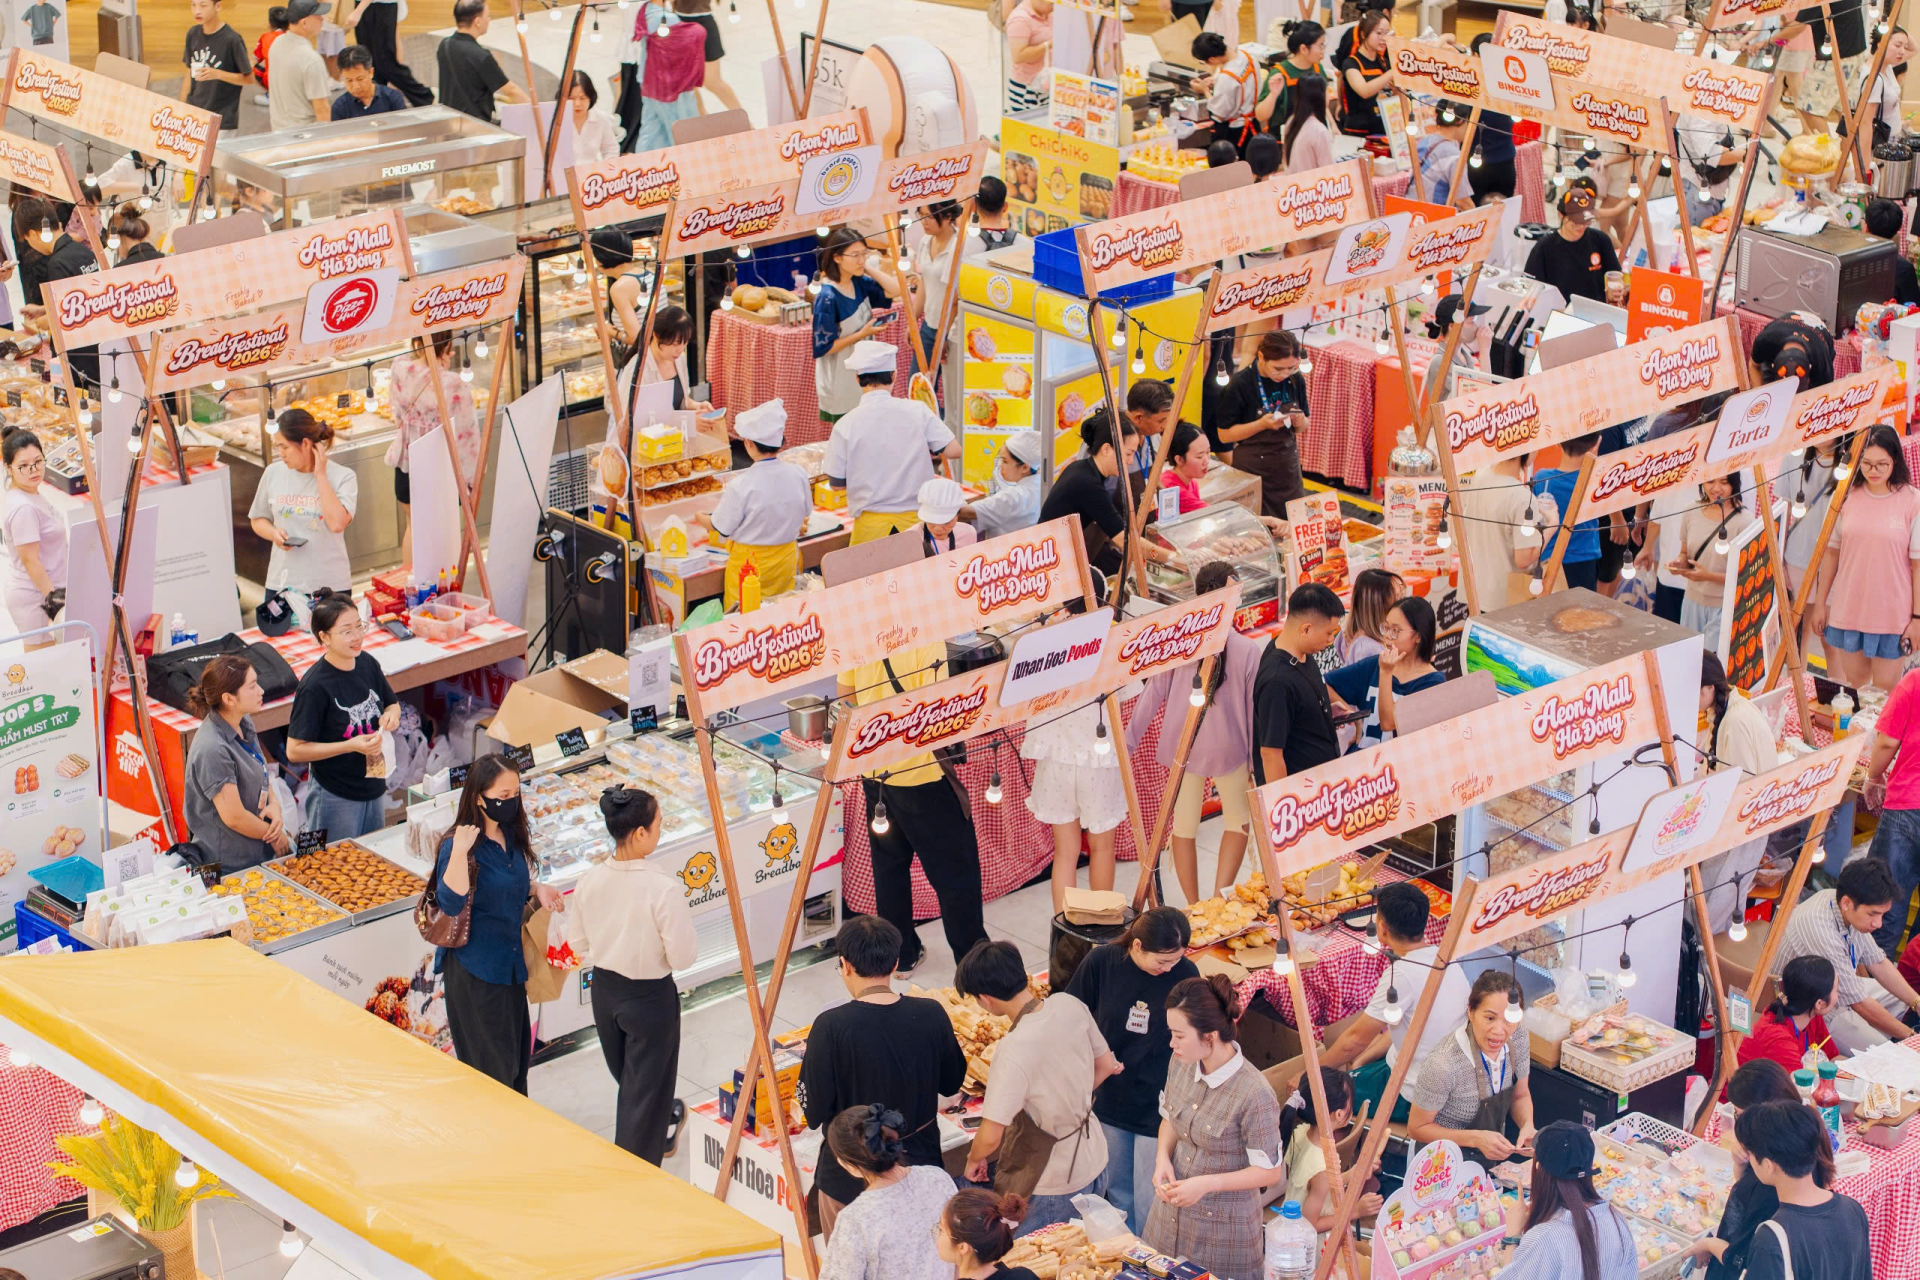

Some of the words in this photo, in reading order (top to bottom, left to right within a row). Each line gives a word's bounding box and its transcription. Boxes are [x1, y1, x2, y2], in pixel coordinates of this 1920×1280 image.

[1504, 24, 1550, 51] Bread
[1541, 36, 1589, 62] Festival
[1397, 49, 1438, 76] Bread
[1433, 60, 1479, 87] Festival
[1548, 57, 1575, 74] 2026
[16, 63, 50, 92] Bread
[43, 75, 81, 100] Festival
[1443, 80, 1470, 96] 2026
[1497, 81, 1541, 98] BINGXUE
[1683, 68, 1719, 94] Aeon
[1716, 76, 1761, 103] Mall
[47, 95, 71, 113] 2026
[1572, 92, 1613, 117] Aeon
[1610, 103, 1648, 127] Mall
[1693, 91, 1715, 110] Hà
[153, 107, 183, 129] Aeon
[181, 115, 209, 141] Mall
[1587, 114, 1610, 130] Hà
[782, 131, 825, 159] Aeon
[821, 124, 858, 148] Mall
[381, 159, 436, 178] FOREMOST
[890, 164, 936, 191] Aeon
[933, 155, 971, 180] Mall
[583, 174, 631, 208] Bread
[624, 164, 677, 199] Festival
[638, 184, 668, 206] 2026
[899, 182, 925, 203] Hà
[921, 177, 955, 198] Đông
[1279, 185, 1321, 216] Aeon
[1316, 176, 1351, 202] Mall
[680, 208, 735, 240] Bread
[729, 196, 783, 230] Festival
[1294, 207, 1319, 228] Hà
[1316, 198, 1345, 221] Đông
[735, 219, 769, 236] 2026
[1408, 232, 1450, 260] Aeon
[1446, 220, 1486, 248] Mall
[301, 235, 349, 264] Aeon
[347, 225, 391, 254] Mall
[1093, 234, 1139, 271] Bread
[1131, 221, 1181, 259] Festival
[1142, 244, 1174, 266] 2026
[1418, 251, 1445, 271] Hà
[1440, 243, 1470, 266] Đông
[320, 259, 347, 279] Hà
[344, 250, 382, 274] Đông
[61, 285, 115, 324] Bread
[112, 276, 175, 318] Festival
[413, 286, 467, 313] Aeon
[460, 273, 505, 300] Mall
[1213, 282, 1267, 316] Bread
[1261, 270, 1311, 306] Festival
[1263, 291, 1297, 311] 2026
[127, 302, 166, 323] 2026
[332, 298, 366, 320] Pizza
[338, 310, 360, 326] Hut
[426, 308, 453, 327] Hà
[450, 298, 491, 320] Đông
[1640, 302, 1688, 321] BINGXUE
[167, 333, 228, 374] Bread
[222, 324, 287, 362] Festival
[232, 350, 272, 368] 2026
[1641, 349, 1682, 381] Aeon
[1679, 336, 1719, 364] Mall
[1658, 374, 1680, 397] Hà
[1678, 366, 1712, 389] Đông
[1798, 396, 1847, 425] Aeon
[1842, 382, 1877, 408] Mall
[1447, 406, 1486, 446] Bread
[1483, 394, 1538, 441] Festival
[1497, 421, 1529, 445] 2026
[1805, 418, 1829, 438] Hà
[1828, 409, 1858, 431] Đông
[1728, 425, 1770, 450] Tarta
[1595, 455, 1646, 498] Bread
[1637, 443, 1697, 487] Festival
[1646, 469, 1681, 490] 2026
[1419, 482, 1448, 493] MENU
[1295, 521, 1324, 541] FREE
[1298, 541, 1303, 551] 1
[1304, 535, 1325, 549] COCA
[957, 558, 1014, 597] Aeon
[1009, 537, 1058, 574] Mall
[1300, 556, 1307, 565] 2
[1749, 557, 1764, 572] TARTA
[979, 582, 1010, 613] Hà
[1006, 570, 1050, 604] Đông
[1745, 593, 1760, 609] TARTA
[875, 625, 904, 645] Freshly
[885, 636, 910, 653] Baked
[1120, 624, 1180, 657] Aeon
[1176, 604, 1222, 638] Mall
[1435, 636, 1456, 652] MENU
[1739, 627, 1755, 644] TARTA
[696, 631, 758, 688] Bread
[750, 615, 822, 671] Festival
[769, 648, 811, 677] 2026
[1066, 637, 1103, 663] Foods
[1133, 648, 1167, 674] Hà
[1163, 632, 1204, 663] Đông
[33, 696, 46, 713] 5
[1533, 696, 1589, 738] Aeon
[1586, 676, 1634, 714] Mall
[23, 718, 48, 737] MUST
[50, 711, 70, 727] TRY
[850, 713, 921, 757] Bread
[910, 685, 986, 741] Festival
[921, 716, 966, 743] 2026
[1554, 726, 1586, 755] Hà
[1583, 711, 1624, 744] Đông
[116, 740, 144, 768] Pizza
[117, 755, 139, 779] Hut
[1451, 774, 1479, 795] Freshly
[1460, 786, 1486, 805] Baked
[1740, 780, 1804, 819] Aeon
[1797, 758, 1842, 793] Mall
[1271, 782, 1333, 845] Bread
[1328, 765, 1396, 823] Festival
[1345, 802, 1386, 834] 2026
[1747, 806, 1783, 832] Hà
[1657, 811, 1701, 837] Sweet
[755, 860, 801, 884] Breadba
[689, 887, 727, 908] eadbae
[1474, 878, 1541, 931] Bread
[1535, 852, 1611, 912] Festival
[1543, 884, 1583, 914] 2026
[704, 1133, 743, 1184] Nhn
[1414, 1165, 1451, 1191] Sweet
